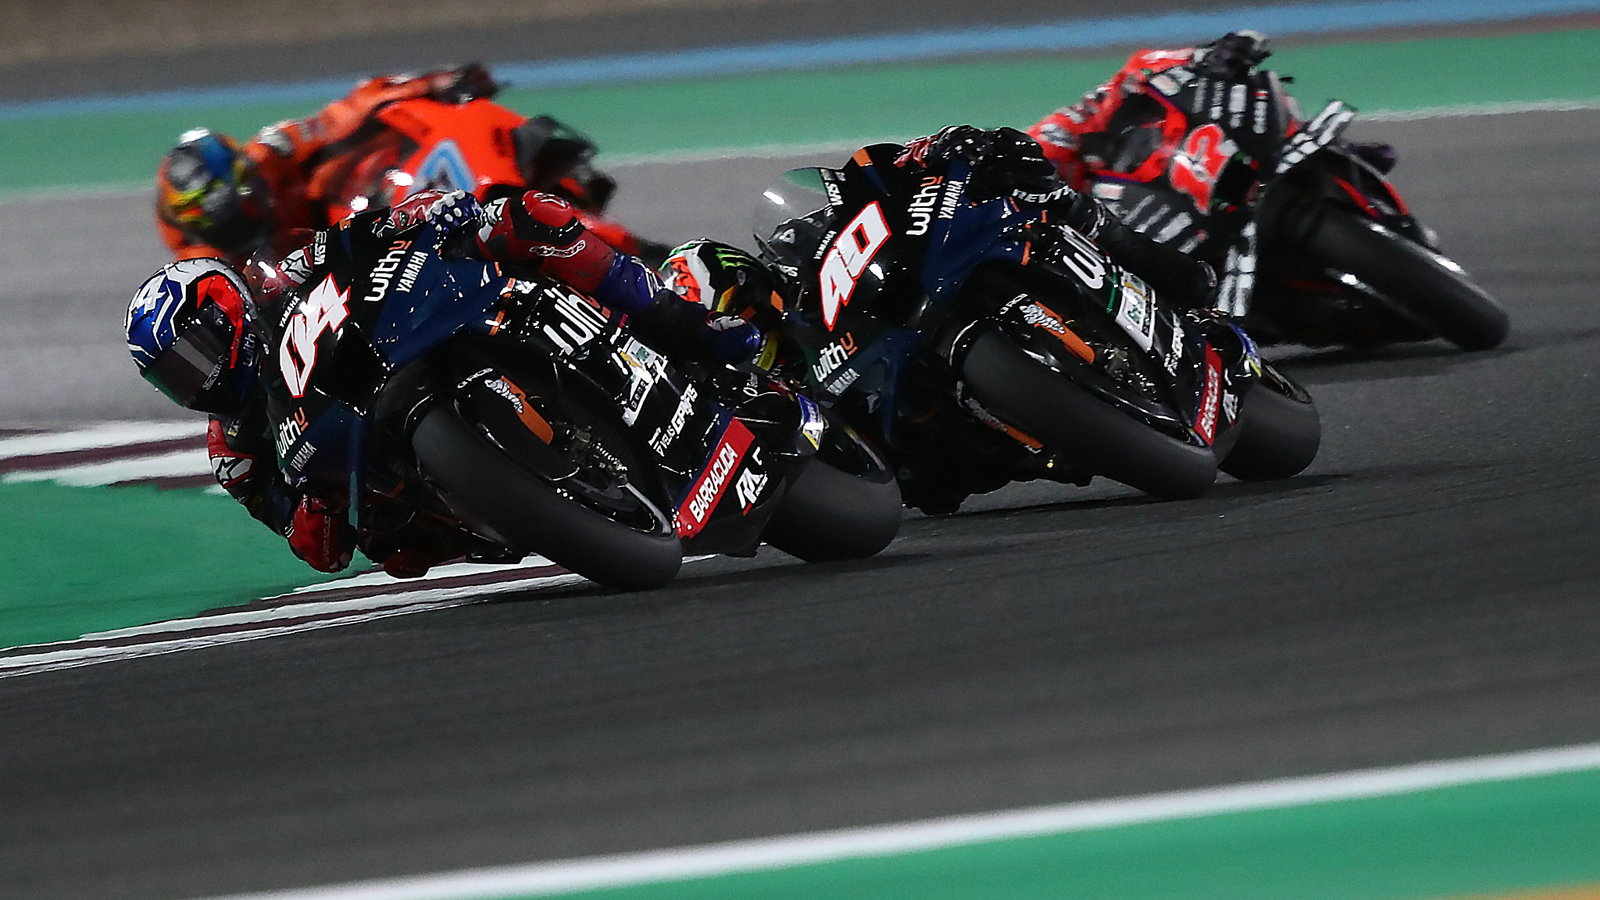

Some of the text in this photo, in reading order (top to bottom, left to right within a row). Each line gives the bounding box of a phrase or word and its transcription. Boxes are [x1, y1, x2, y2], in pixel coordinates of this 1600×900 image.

[938, 180, 964, 219] YAMAHA
[813, 230, 837, 260] YAMAHA
[395, 251, 429, 293] YAMAHA
[818, 200, 892, 333] 40
[279, 295, 301, 328] YAMAHA
[279, 272, 351, 398] 04
[290, 440, 318, 473] YAMAHA
[688, 442, 739, 523] BARRACUDA
